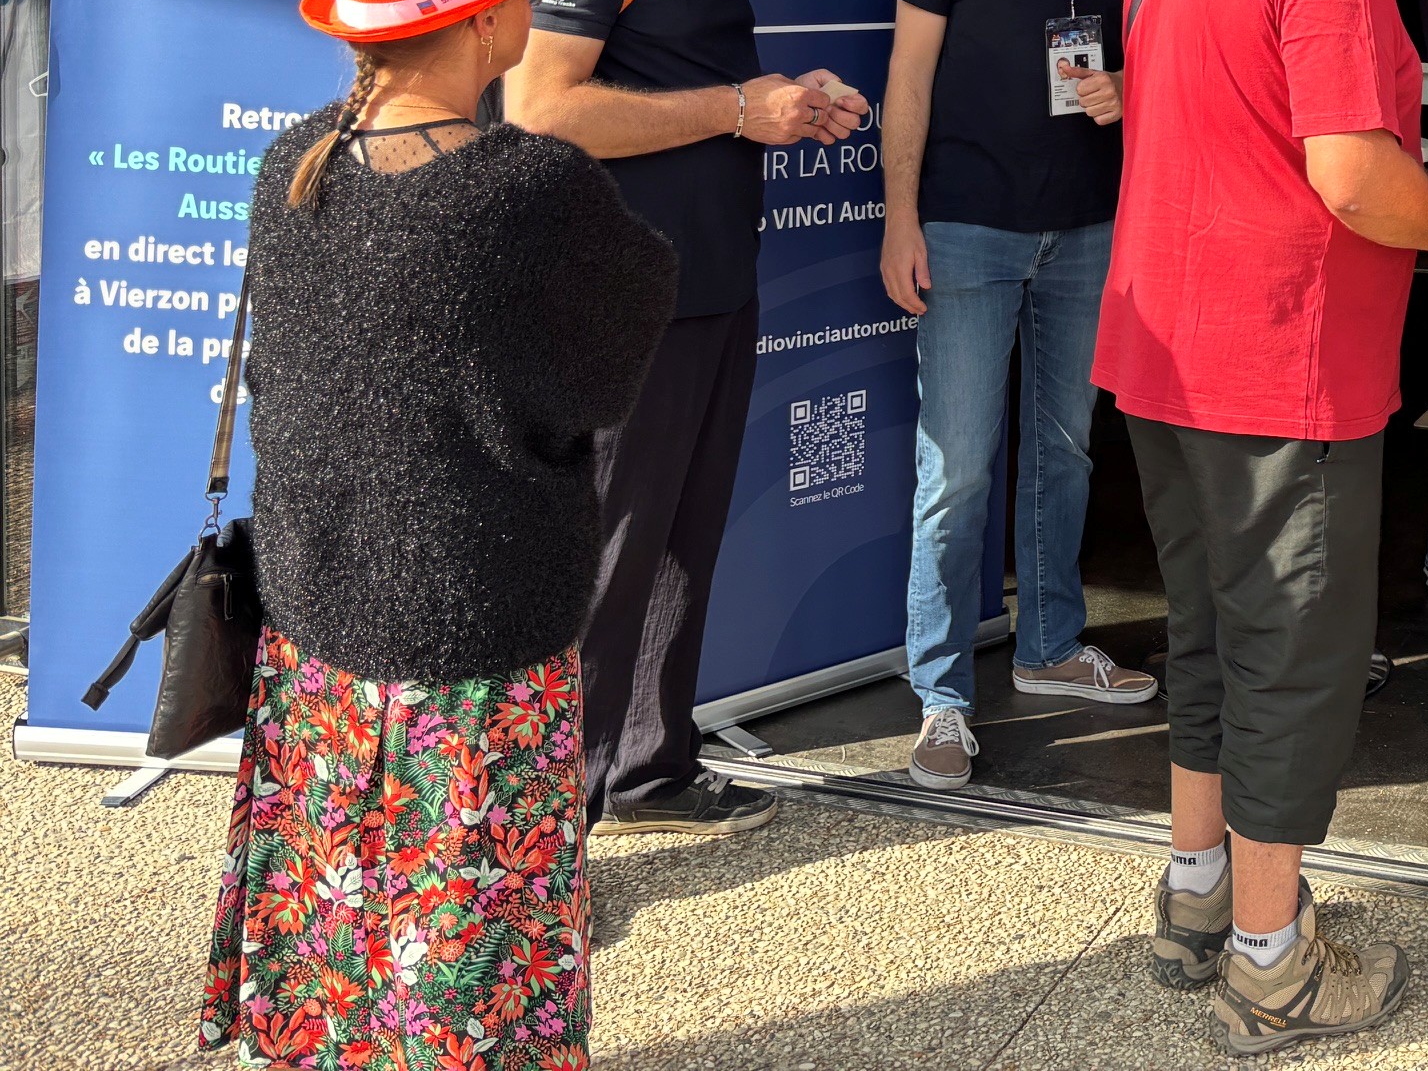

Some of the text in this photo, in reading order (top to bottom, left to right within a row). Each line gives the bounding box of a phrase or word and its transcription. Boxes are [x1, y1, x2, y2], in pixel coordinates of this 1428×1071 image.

[222, 103, 309, 130] Retro
[114, 144, 160, 170] Les
[168, 146, 264, 175] Routie
[799, 147, 831, 178] LA
[840, 143, 884, 174] RO
[178, 193, 252, 221] Auss
[772, 202, 833, 230] VINCI
[839, 201, 886, 223] Auto
[84, 239, 120, 261] en
[128, 235, 215, 266] direct
[74, 277, 91, 305] à
[100, 280, 209, 312] Vierzon
[123, 327, 250, 364] de la pre
[756, 314, 919, 355] diovinciautoroute
[790, 483, 865, 507] Scannez le QR Code
[1171, 856, 1197, 866] UMA
[1250, 1006, 1288, 1026] MERRELL
